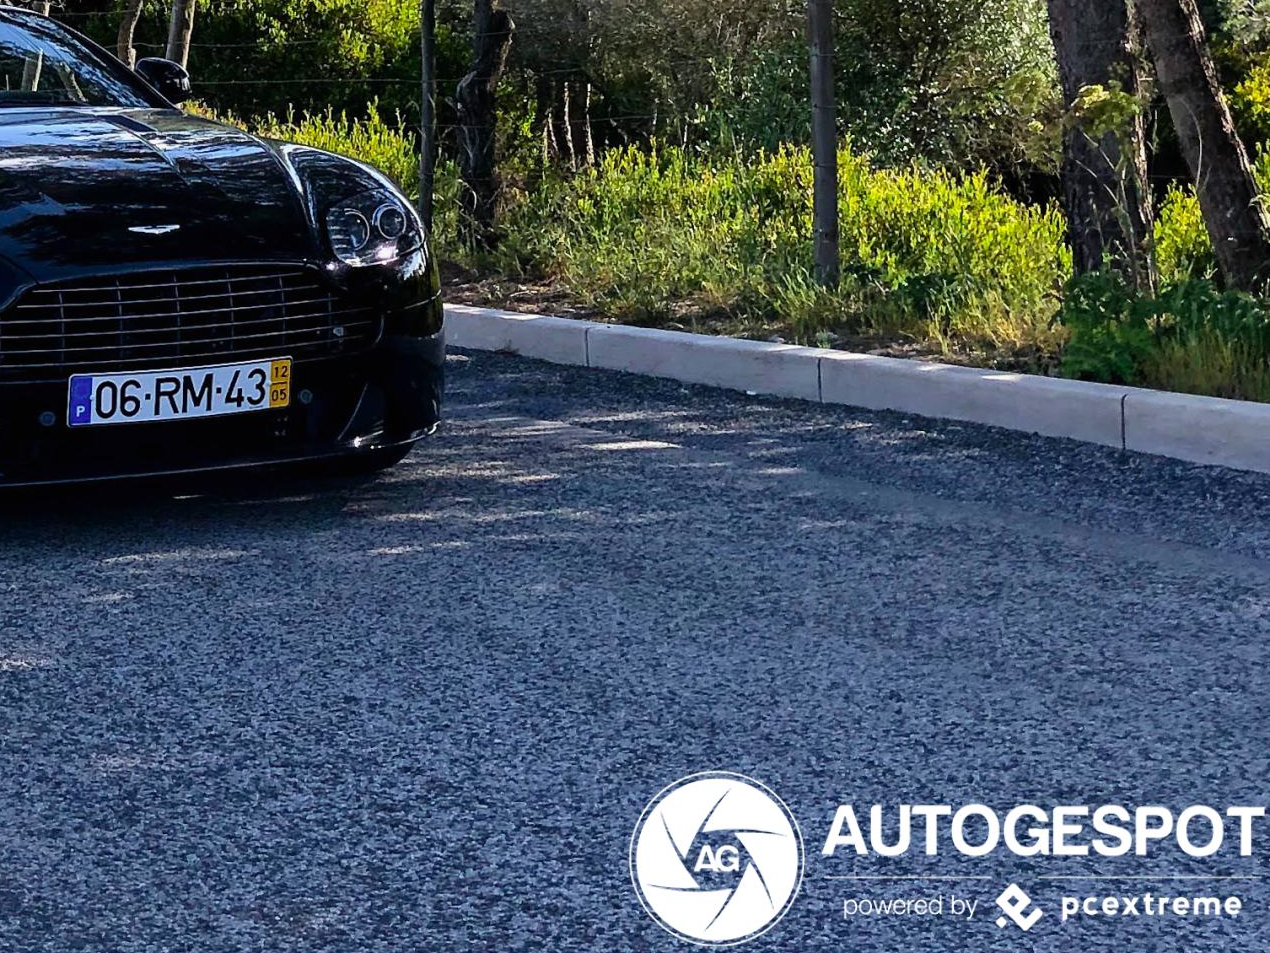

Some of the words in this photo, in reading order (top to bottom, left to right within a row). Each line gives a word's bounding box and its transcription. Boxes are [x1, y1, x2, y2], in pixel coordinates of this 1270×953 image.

[273, 365, 288, 379] 12
[271, 388, 288, 402] 05
[75, 405, 86, 418] P
